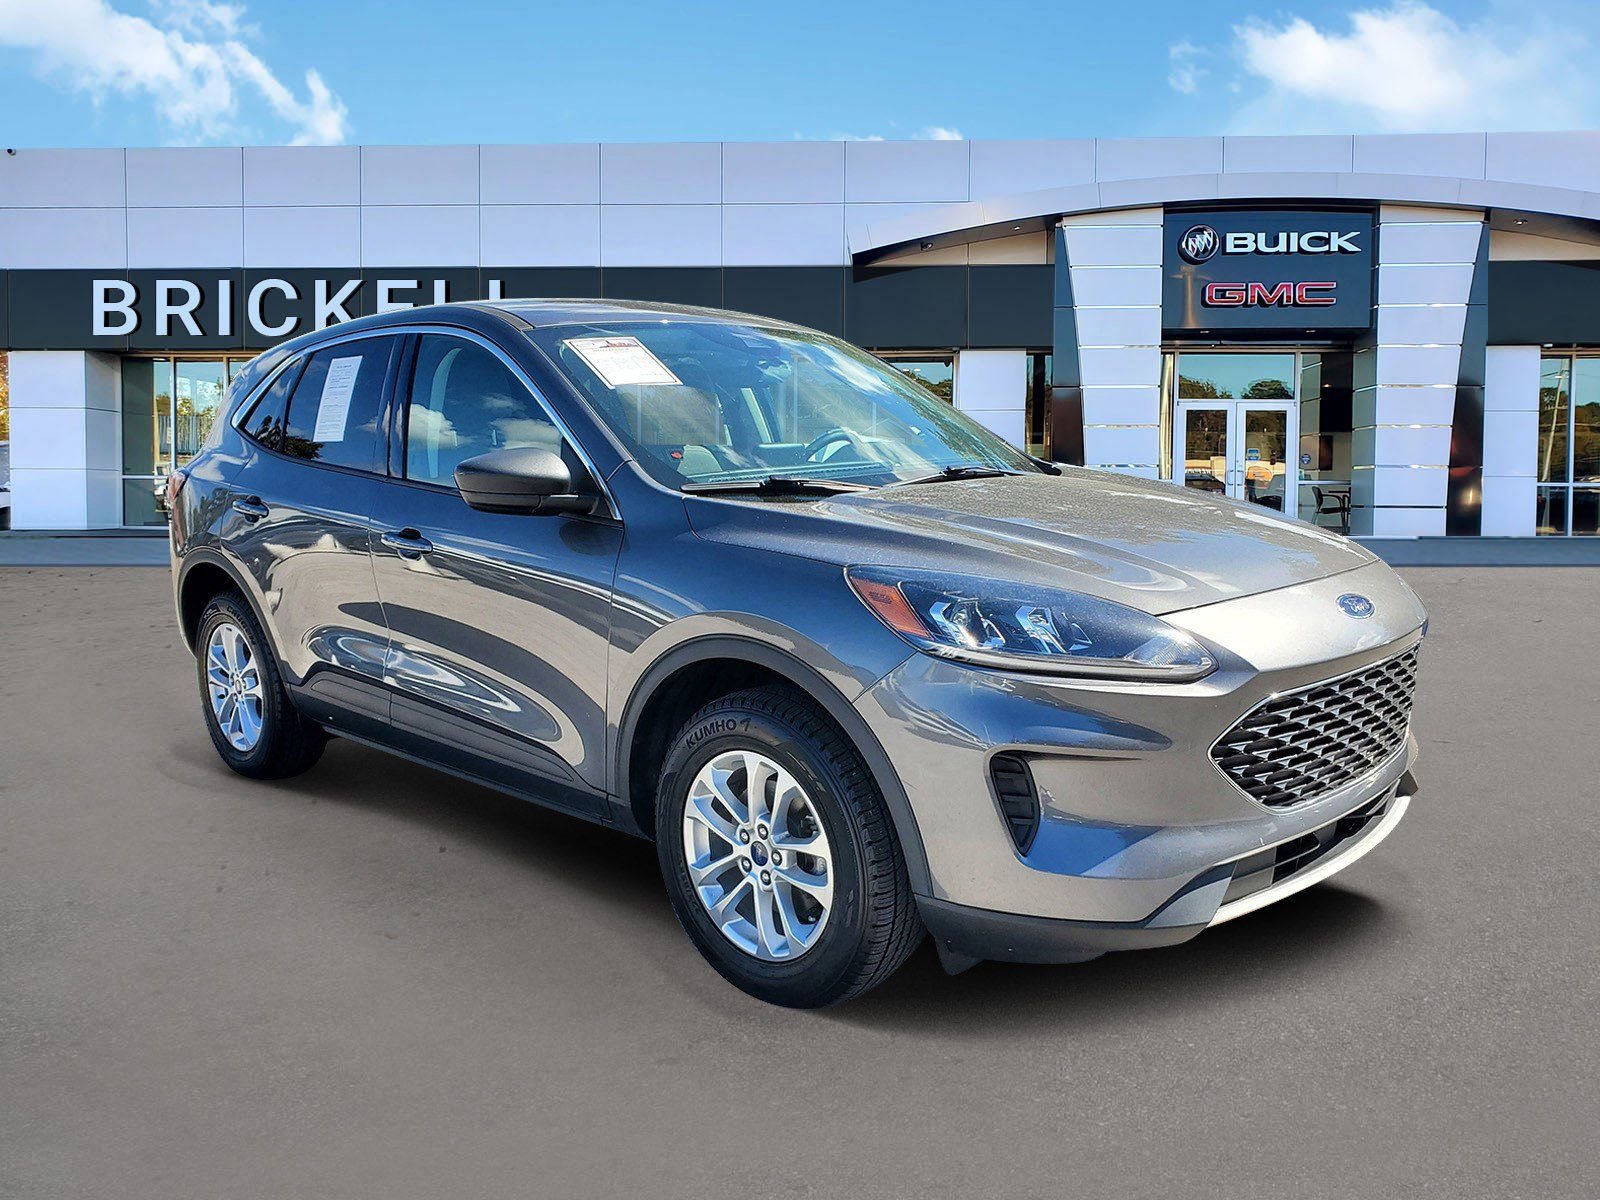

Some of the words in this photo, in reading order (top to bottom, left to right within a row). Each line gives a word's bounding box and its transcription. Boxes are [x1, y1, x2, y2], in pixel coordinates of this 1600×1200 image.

[1225, 231, 1361, 253] BUICK
[1205, 281, 1337, 305] GMC
[685, 718, 737, 749] KUMHO
